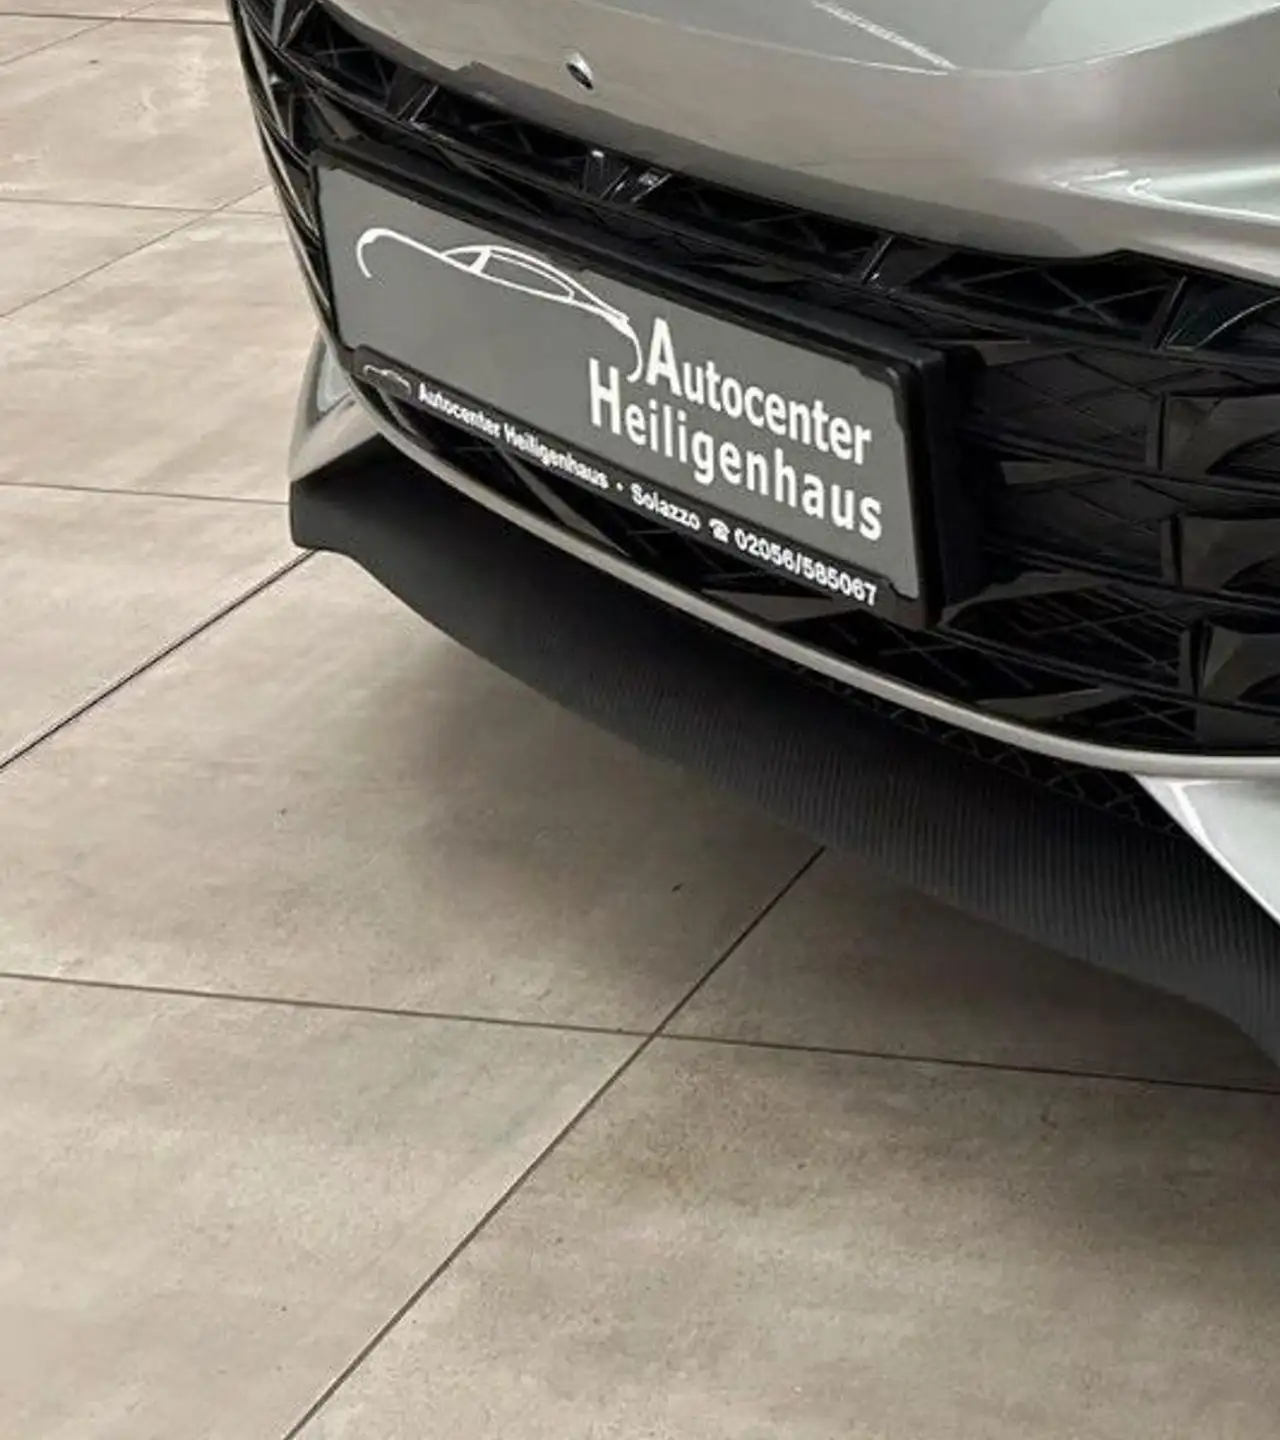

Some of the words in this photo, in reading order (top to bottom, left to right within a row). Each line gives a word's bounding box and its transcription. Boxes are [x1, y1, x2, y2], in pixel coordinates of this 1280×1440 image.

[589, 357, 882, 541] Heiligenhaus
[646, 317, 872, 465] Autocenter
[418, 382, 501, 438] Autocenter
[503, 422, 609, 489] Heiligenhaus
[630, 483, 701, 531] Solazzo
[734, 528, 877, 606] 02056/585067
